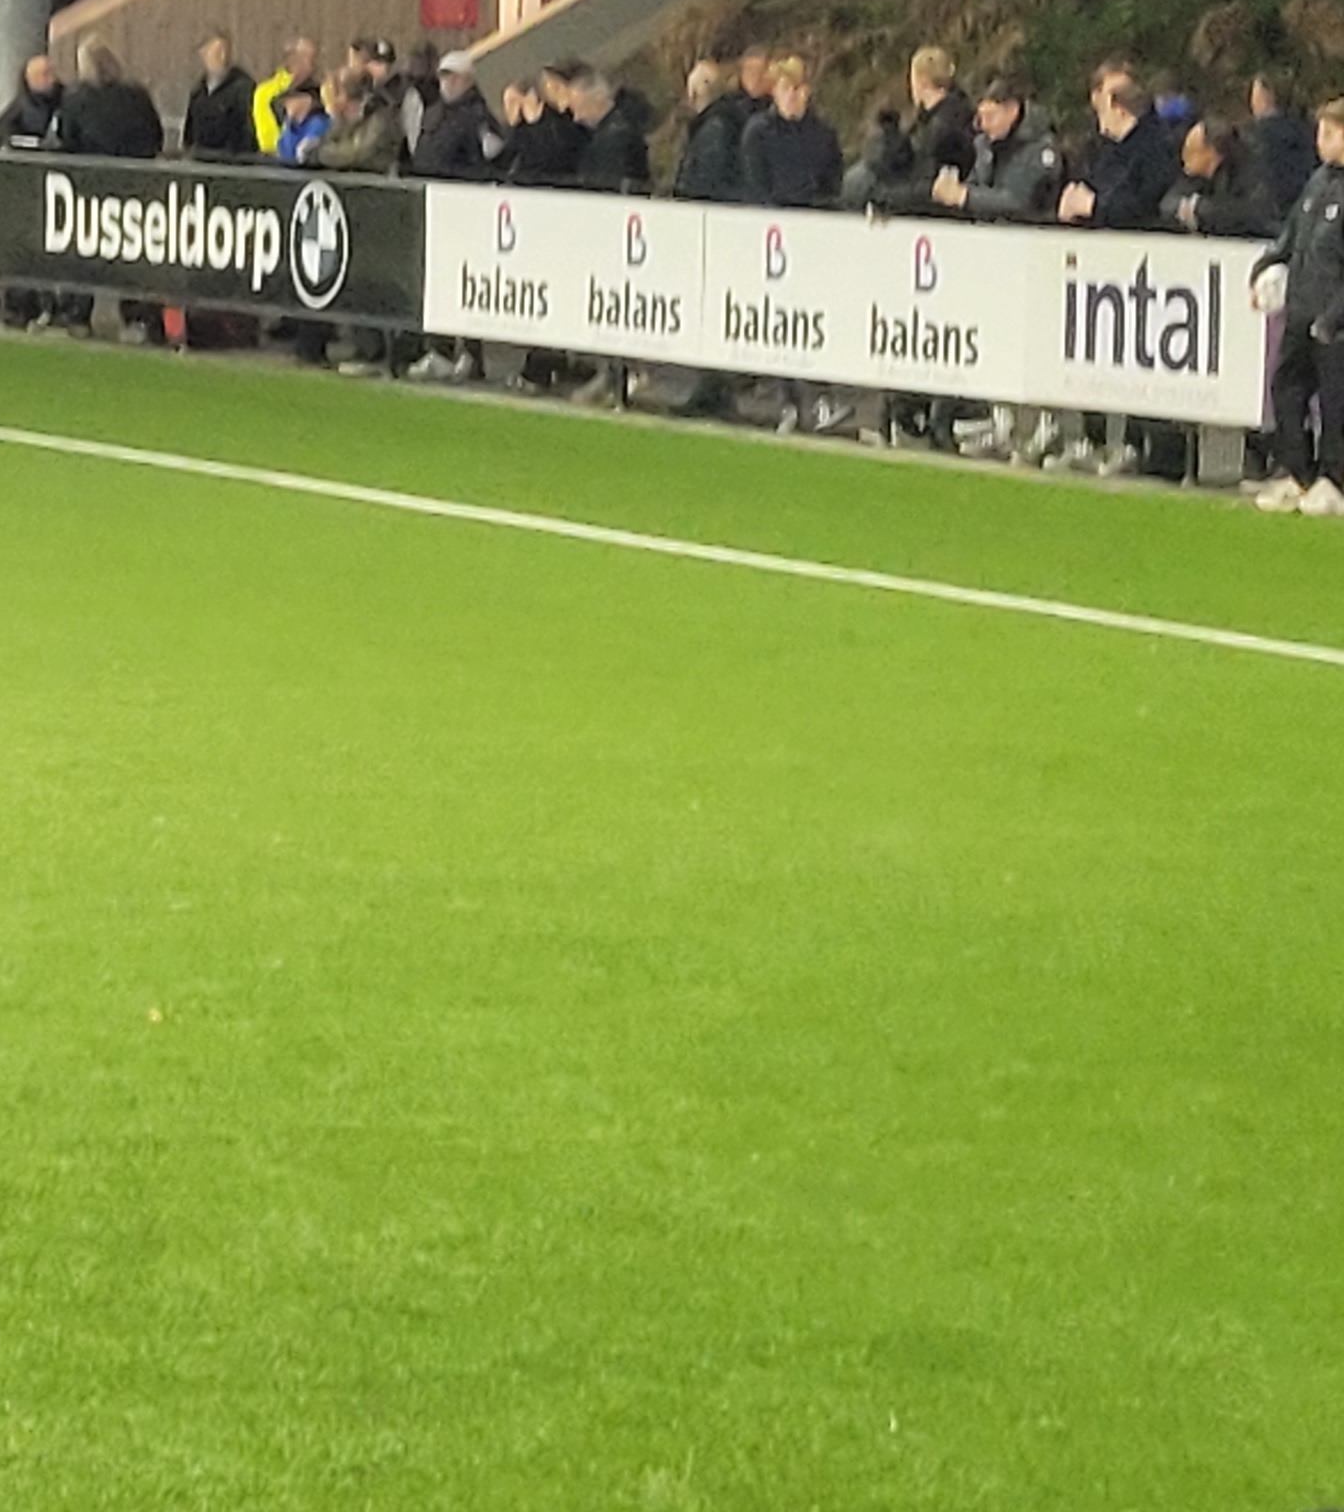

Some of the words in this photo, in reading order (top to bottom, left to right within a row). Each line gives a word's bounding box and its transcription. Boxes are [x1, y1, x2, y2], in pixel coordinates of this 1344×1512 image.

[45, 171, 281, 291] Dusseldorp
[461, 260, 549, 319] balans
[588, 274, 681, 335] balans
[724, 287, 825, 351] balans
[1064, 251, 1221, 378] intal
[870, 300, 979, 368] balans
